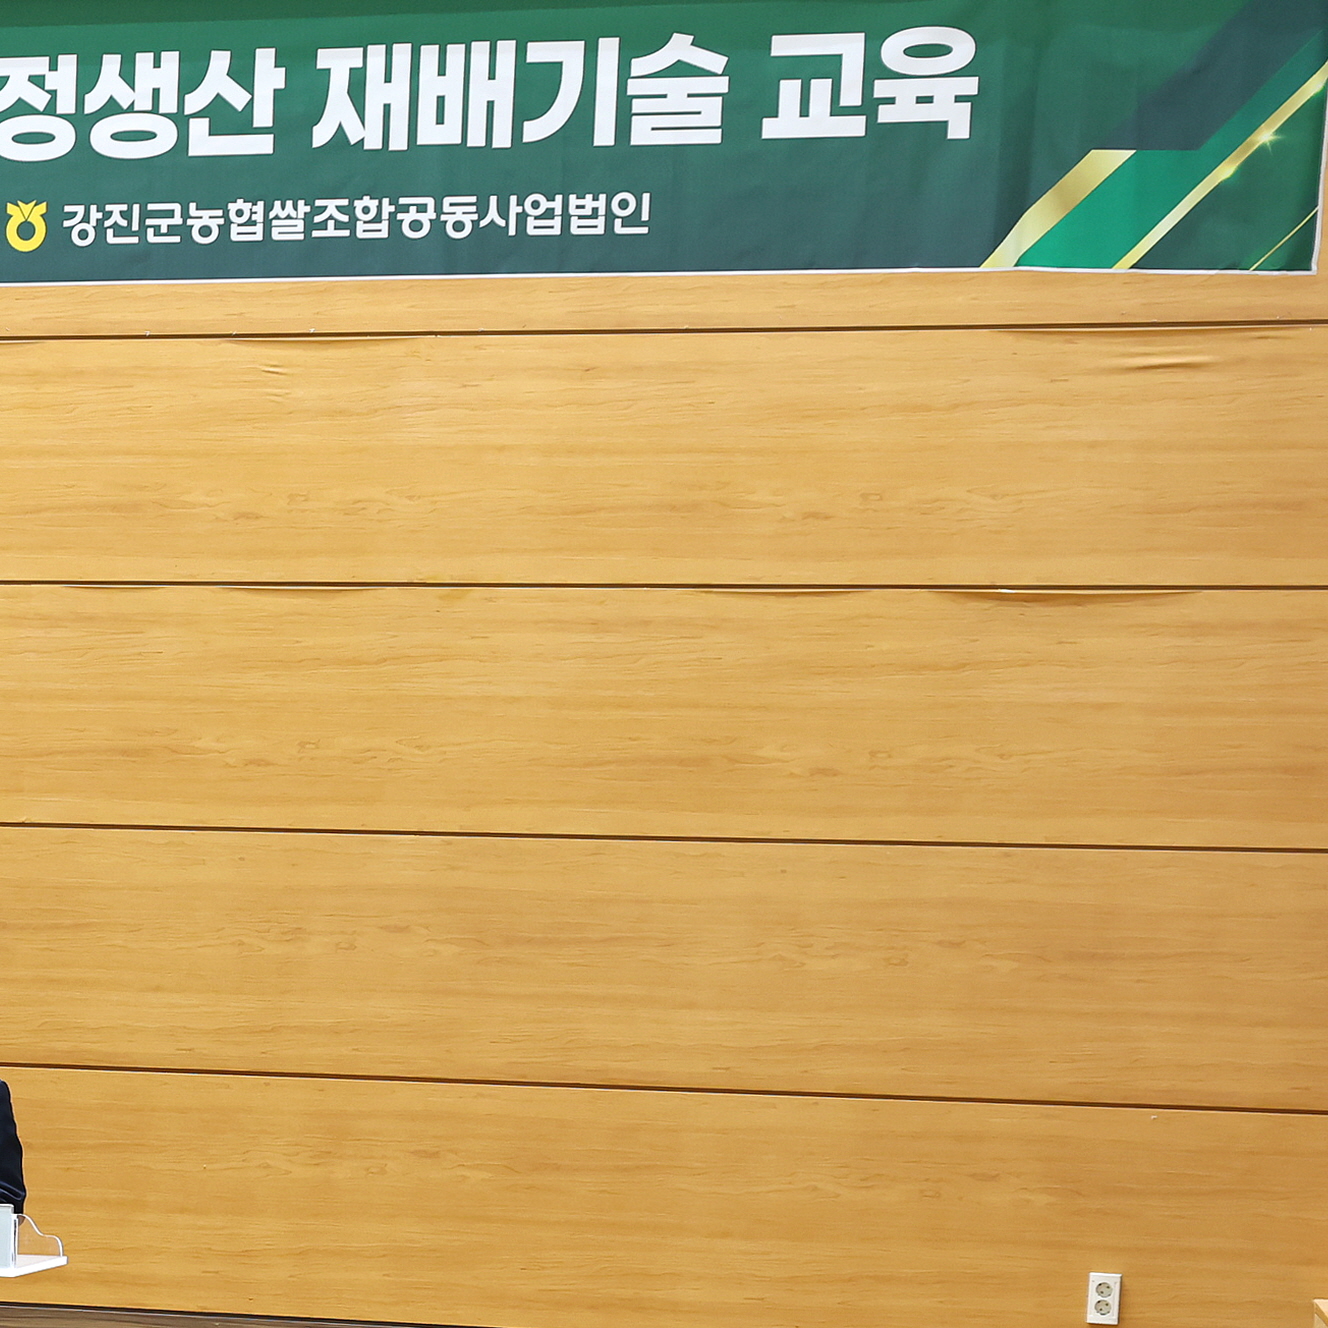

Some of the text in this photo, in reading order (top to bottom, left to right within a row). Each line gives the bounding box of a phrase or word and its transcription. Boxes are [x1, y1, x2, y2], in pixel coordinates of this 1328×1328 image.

[312, 32, 730, 151] 재배기술
[761, 25, 980, 139] 교육
[62, 192, 651, 248] 강진군농협쌀조합공동사업법인
